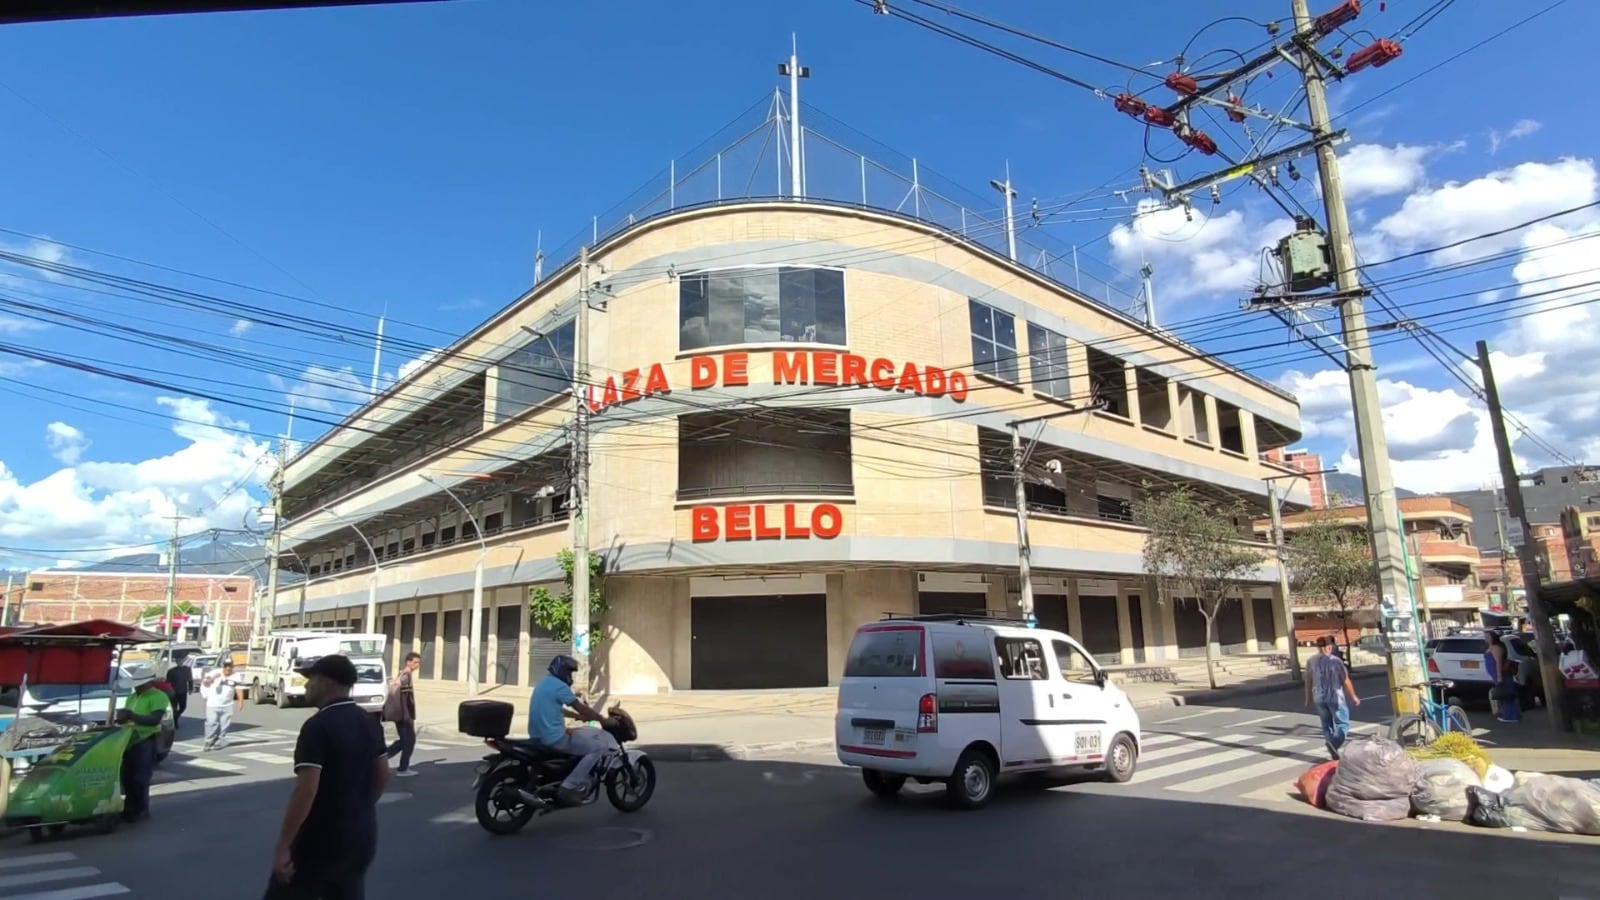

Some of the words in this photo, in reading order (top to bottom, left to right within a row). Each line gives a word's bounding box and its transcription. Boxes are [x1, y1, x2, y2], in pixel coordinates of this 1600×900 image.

[588, 362, 670, 413] LAZA
[691, 351, 748, 390] DE
[772, 349, 967, 405] MERCADO
[691, 502, 843, 543] BELLO
